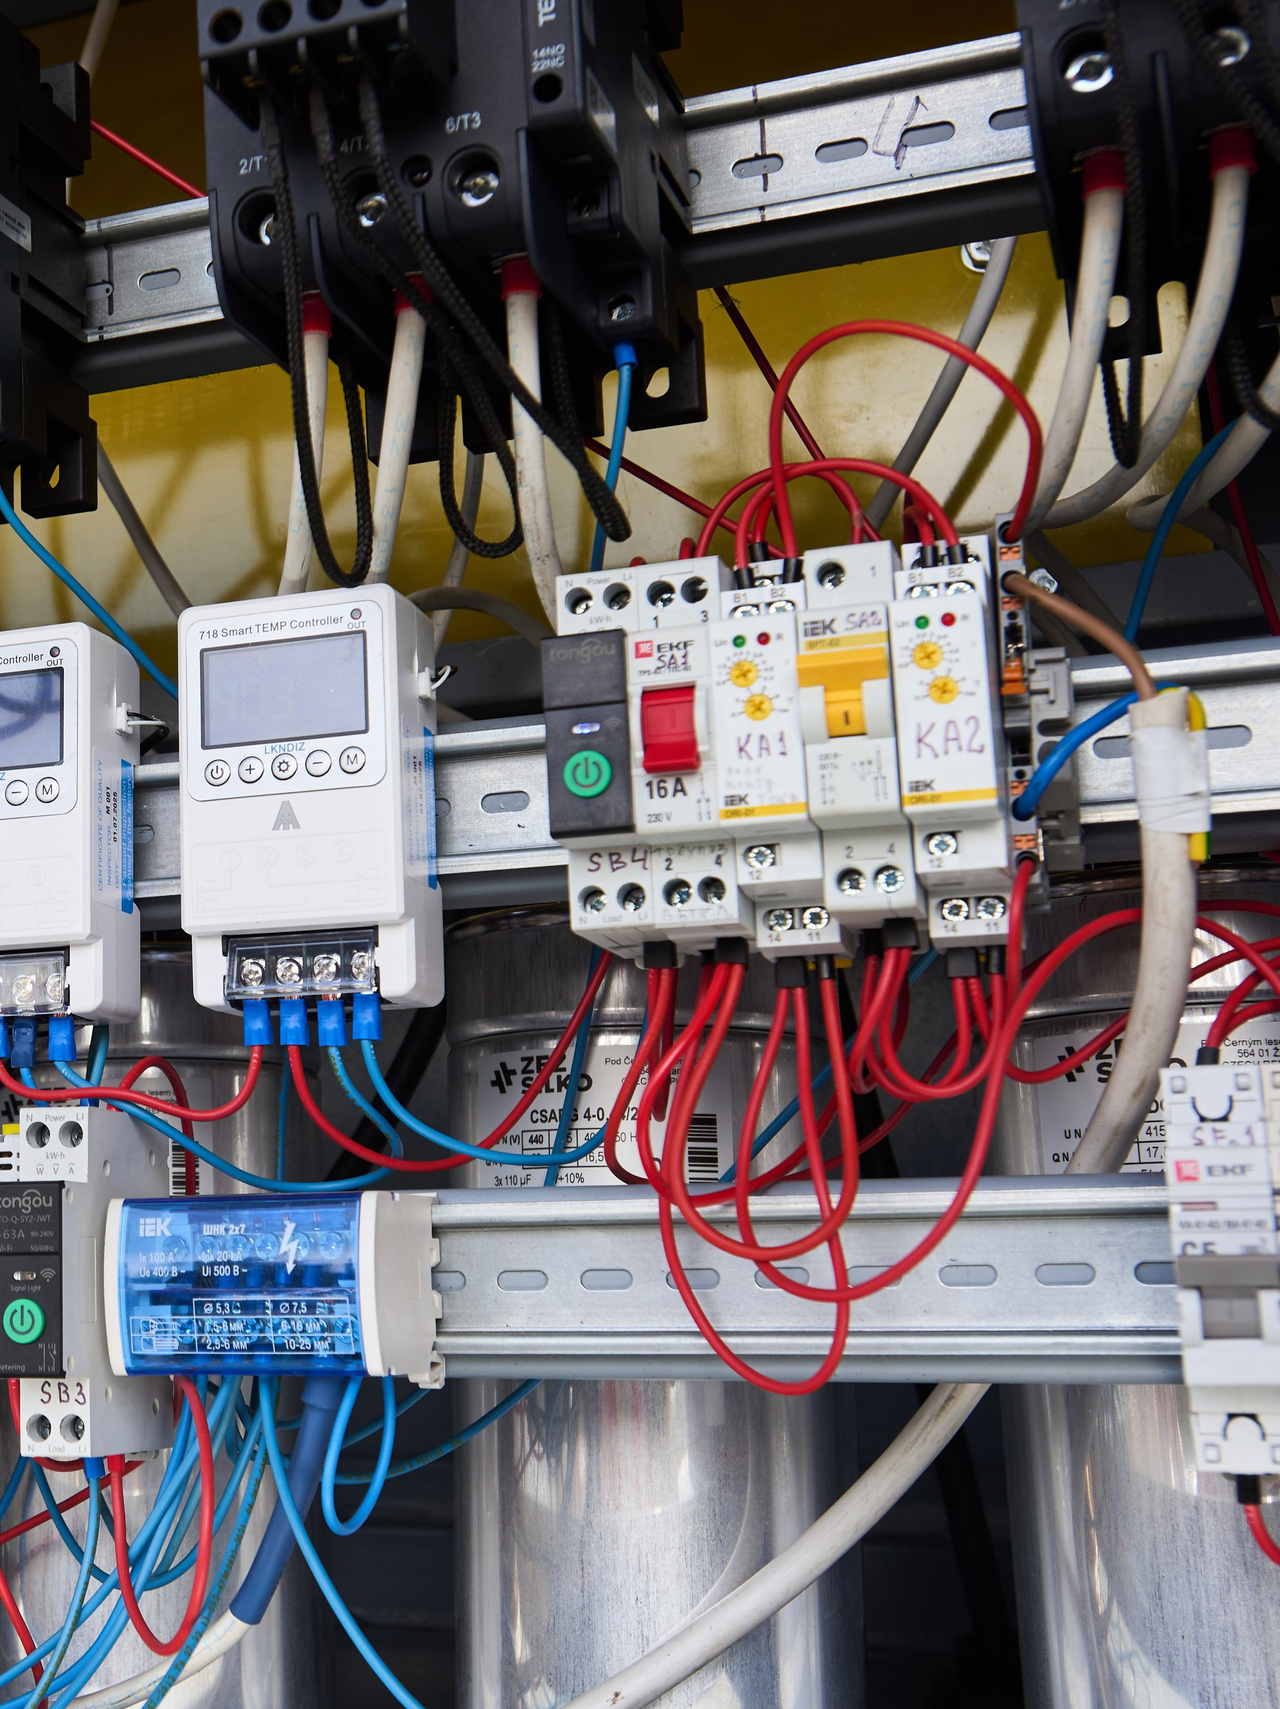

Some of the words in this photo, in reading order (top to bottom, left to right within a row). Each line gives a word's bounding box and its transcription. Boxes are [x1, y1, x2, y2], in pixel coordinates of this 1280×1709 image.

[532, 43, 566, 59] 14NO
[532, 56, 566, 73] 22NC
[445, 111, 482, 135] 6/T3
[909, 572, 924, 583] B1
[948, 567, 965, 578] B2
[733, 593, 748, 603] B1
[771, 587, 787, 598] B2
[199, 628, 219, 640] 718
[221, 625, 253, 638] Smart
[254, 620, 288, 634] TEMP
[289, 614, 344, 630] Controller
[347, 620, 366, 630] OUT
[657, 640, 695, 653] EKF
[46, 658, 64, 667] OUT
[916, 715, 985, 759] KA2
[264, 742, 306, 755] LKNDIZ
[737, 731, 788, 761] KA1
[646, 778, 669, 799] 16
[673, 776, 688, 797] A
[647, 813, 663, 824] 230
[587, 847, 649, 873] SB4
[928, 857, 944, 869] 12
[749, 870, 763, 881] 12
[944, 923, 958, 934] 14
[986, 922, 999, 932] 11
[768, 932, 782, 943] 14
[808, 930, 820, 942] 11
[1223, 1036, 1263, 1049] Černým
[1237, 1049, 1256, 1058] 564
[1259, 1048, 1270, 1057] 01
[604, 1057, 622, 1066] Pod
[44, 1113, 66, 1123] Power
[1145, 1126, 1167, 1137] 415
[528, 1134, 544, 1145] 440
[1206, 1164, 1255, 1177] EKF
[494, 1175, 503, 1187] 3x
[504, 1175, 518, 1186] 110
[520, 1174, 532, 1187] µF
[30, 1230, 55, 1238] 90-240V
[203, 1224, 226, 1236] ШНК
[227, 1223, 246, 1235] 2x7
[30, 1244, 55, 1252] 50/60Hz
[148, 1252, 166, 1262] 100
[217, 1252, 229, 1262] 20
[138, 1267, 151, 1278] Ue
[152, 1266, 169, 1277] 400
[202, 1266, 212, 1277] Ui
[214, 1265, 231, 1277] 500
[10, 1284, 24, 1293] Signal
[25, 1284, 42, 1292] Light
[215, 1302, 231, 1315] 5,3
[292, 1301, 308, 1314] 7,5
[205, 1338, 230, 1350] 2,5-6
[283, 1338, 312, 1350] 10-25
[41, 1381, 87, 1405] SB3
[48, 1443, 65, 1452] Load
